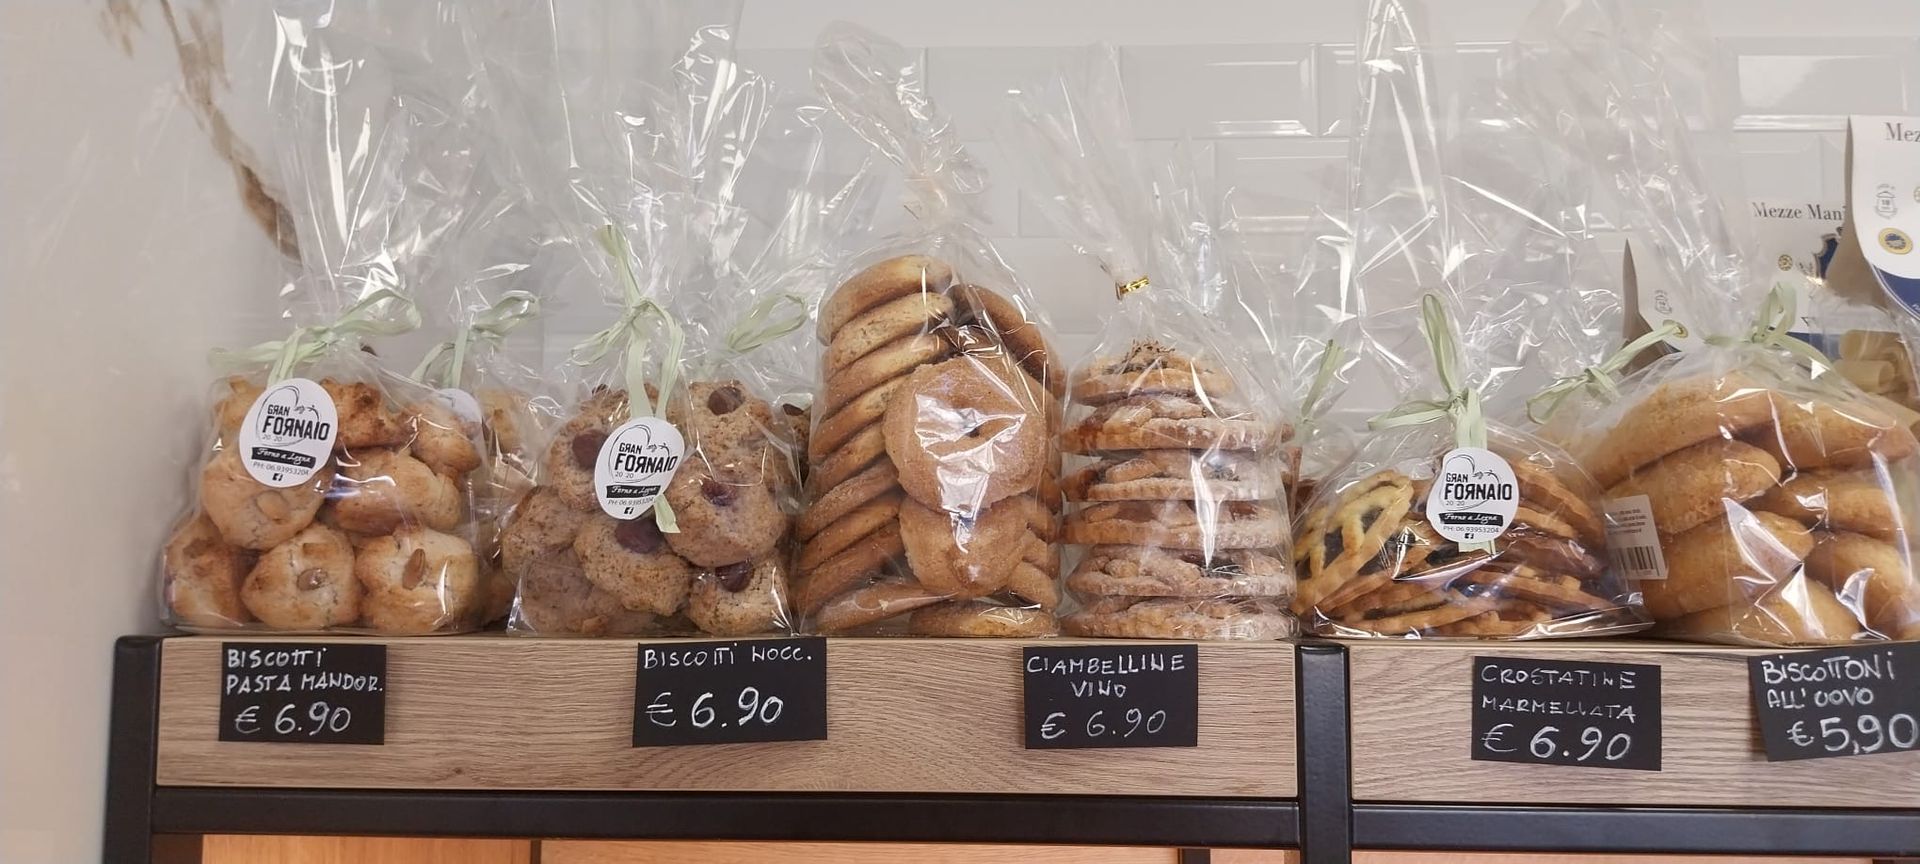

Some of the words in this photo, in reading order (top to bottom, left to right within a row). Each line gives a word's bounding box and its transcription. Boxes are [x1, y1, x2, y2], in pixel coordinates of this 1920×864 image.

[1751, 202, 1802, 219] Mezze
[1806, 203, 1845, 221] Man
[267, 404, 290, 416] GRAN
[262, 416, 330, 441] FORNAIO
[619, 442, 642, 454] GRAN
[614, 453, 678, 473] FORNAIO
[1445, 472, 1468, 483] GRAN
[1444, 483, 1512, 501] FORNAIO
[227, 647, 327, 668] BISCOTTI
[644, 643, 738, 669] BISCOTTI
[752, 645, 812, 662] NOCC.
[1026, 653, 1185, 675] CIAMBELLINE
[1761, 651, 1895, 684] BISCOTTONI
[226, 673, 292, 695] PASTA
[301, 671, 383, 692] MANDOR.
[1070, 679, 1126, 698] VINO
[1481, 664, 1636, 689] CROSTATINE
[645, 692, 677, 727] €
[691, 686, 784, 728] 6.90
[1481, 694, 1636, 723] MARMELLATA
[1767, 687, 1806, 709] ALL'
[235, 705, 261, 734] €
[274, 701, 352, 736] 6.90
[1040, 712, 1066, 739] €
[1086, 707, 1166, 738] 6.90
[1481, 723, 1517, 752] €
[1529, 726, 1631, 761] 6.90
[1786, 720, 1814, 746] €
[1819, 713, 1919, 755] 5,90
